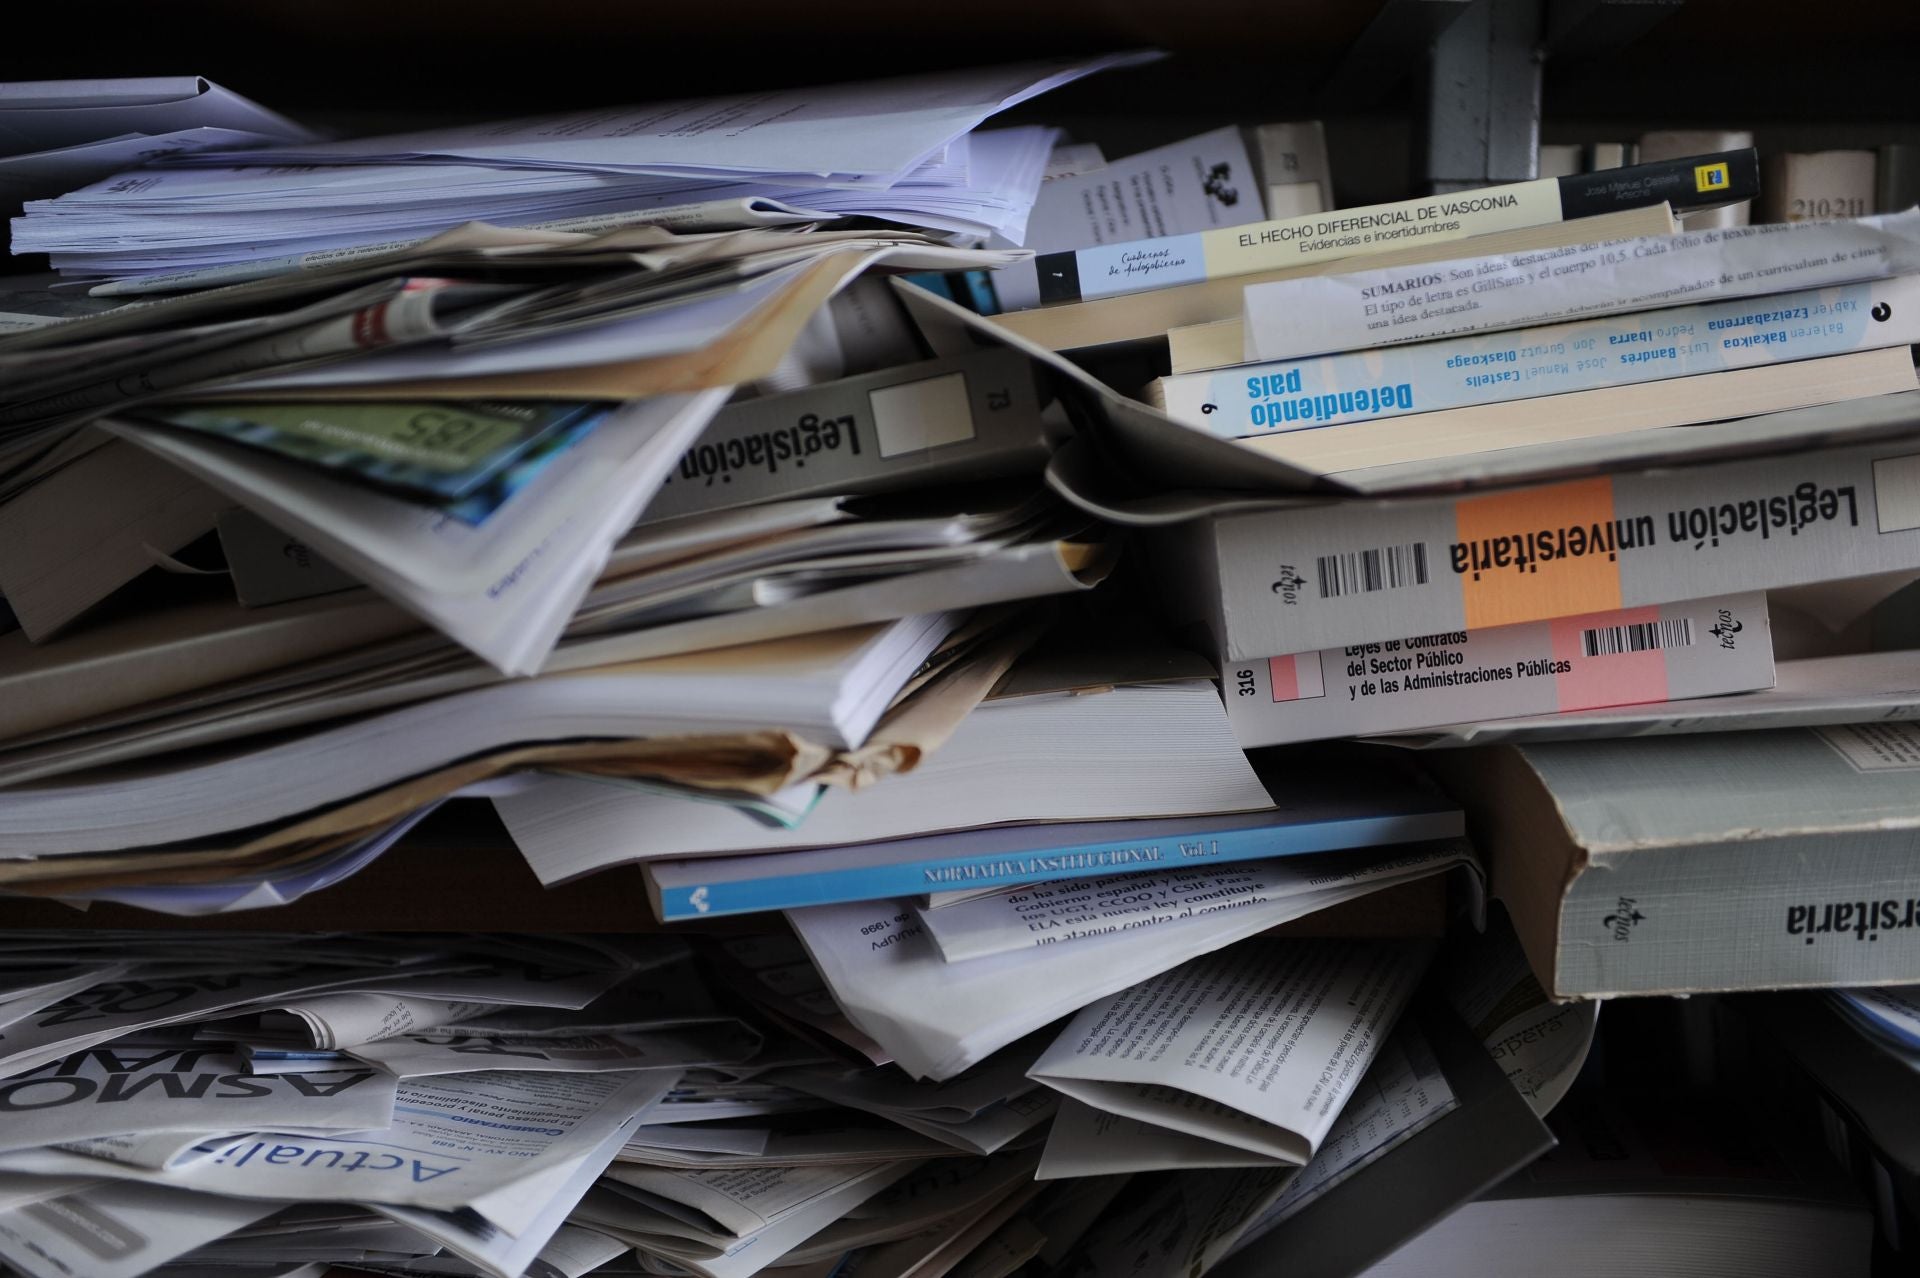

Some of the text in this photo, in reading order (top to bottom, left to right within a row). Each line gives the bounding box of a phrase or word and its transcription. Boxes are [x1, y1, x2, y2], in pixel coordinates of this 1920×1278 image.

[1239, 195, 1518, 247] EL HECHO DIFERENCIAL DE VASCONIA
[1299, 220, 1460, 252] Evidencias e incertidumbres
[1108, 258, 1186, 277] de Autogobierno
[1121, 249, 1170, 263] Cuadernos
[1364, 303, 1379, 317] El
[1382, 299, 1405, 314] tipo
[1408, 294, 1423, 306] de
[1425, 287, 1454, 303] letra
[1456, 287, 1470, 297] es
[1472, 274, 1525, 295] GillSans
[1528, 273, 1536, 286] y
[1539, 267, 1550, 279] el
[1554, 258, 1596, 278] cuerpo
[1634, 244, 1667, 259] Cada
[1670, 235, 1701, 252] folio
[1703, 231, 1720, 244] de
[1722, 225, 1756, 241] texto
[1450, 265, 1474, 280] Son
[1477, 260, 1508, 278] ideas
[1512, 246, 1577, 267] destacadas
[1631, 280, 1715, 303] acompañados
[1718, 272, 1734, 285] de
[1737, 271, 1754, 281] un
[1831, 252, 1848, 264] de
[1367, 319, 1389, 330] una
[1392, 312, 1418, 326] idea
[1446, 300, 1858, 369] Xabier Ezeizabarrena Pedro Ibarra Jon Gurutz Olaskoaga
[1465, 322, 1844, 388] Baleren Bakaikoa Luis Bandrés José Manuel Castells
[1247, 369, 1302, 402] país
[1250, 384, 1413, 428] Defendiendo
[681, 414, 861, 488] Legislación
[1449, 482, 1858, 581] Legislación universitaria
[1345, 630, 1468, 658] Leyes de Contratos
[1347, 650, 1464, 677] del Sector Público
[1349, 658, 1571, 701] y de las Administraciones Públicas
[1238, 669, 1255, 697] 316
[924, 860, 1026, 884] NORMATIVA
[1030, 847, 1164, 873] INSTITUCIONAL
[1178, 841, 1207, 858] Vol.
[1008, 893, 1028, 904] do
[1035, 888, 1054, 899] ha
[1057, 883, 1091, 895] sido
[1015, 894, 1091, 912] Gobierno
[1095, 879, 1157, 899] español
[1160, 879, 1171, 887] y
[1174, 871, 1198, 884] los
[1022, 874, 1252, 922] tos UGT, CCOO y CSIF. Para
[1028, 882, 1266, 932] ELA esta nueva ley constituye
[860, 913, 910, 936] de 1998
[1123, 913, 1174, 931] contra
[1179, 907, 1193, 919] el
[1786, 899, 1920, 944] rsitaria
[410, 1092, 488, 1108] disciplinario
[458, 1104, 465, 1112] y
[467, 1108, 504, 1120] penal
[490, 1104, 582, 1120] procedimiento
[506, 1113, 560, 1125] proceso
